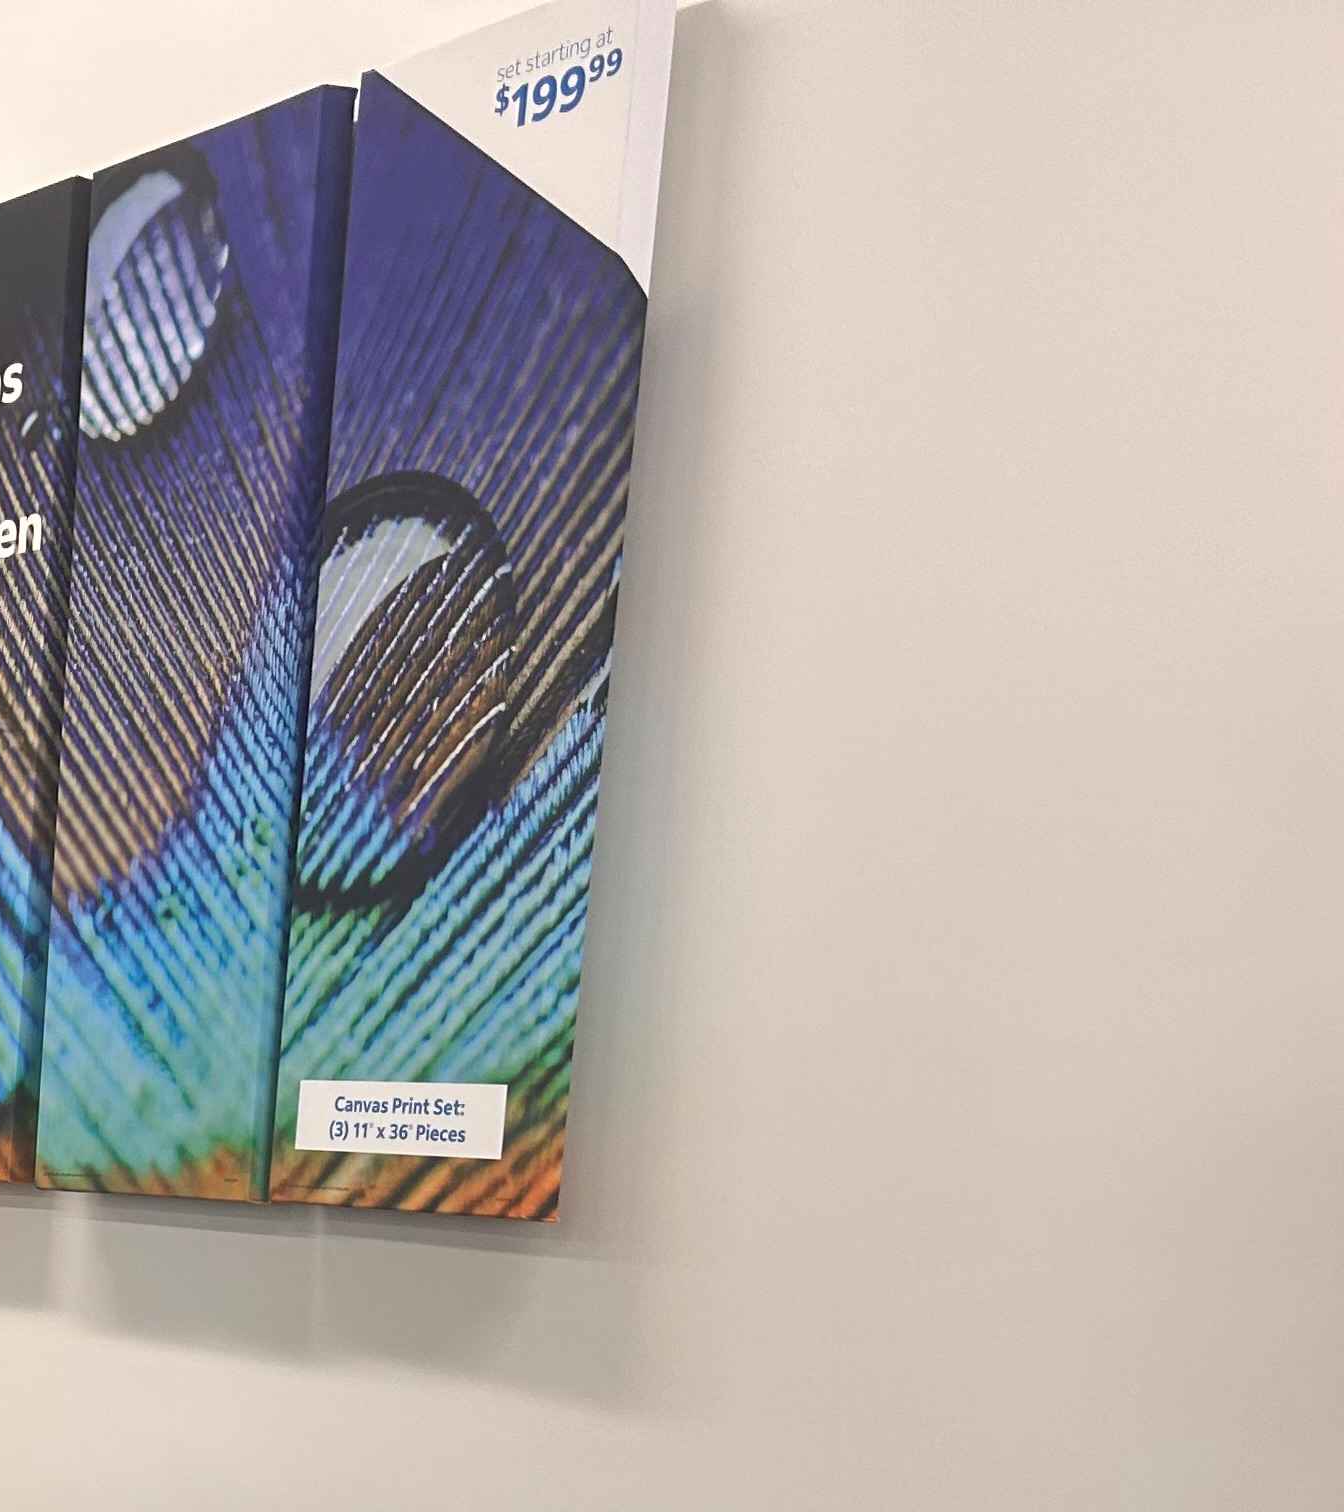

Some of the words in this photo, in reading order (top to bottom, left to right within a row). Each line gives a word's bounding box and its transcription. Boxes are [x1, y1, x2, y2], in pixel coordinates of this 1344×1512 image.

[497, 59, 521, 82] set
[526, 37, 591, 73] starting
[596, 24, 613, 48] at
[334, 1096, 388, 1114] Canvas
[392, 1098, 429, 1115] Print
[433, 1099, 465, 1116] Set:
[329, 1120, 349, 1141] (3)
[376, 1127, 385, 1139] x
[416, 1125, 466, 1143] Pieces
